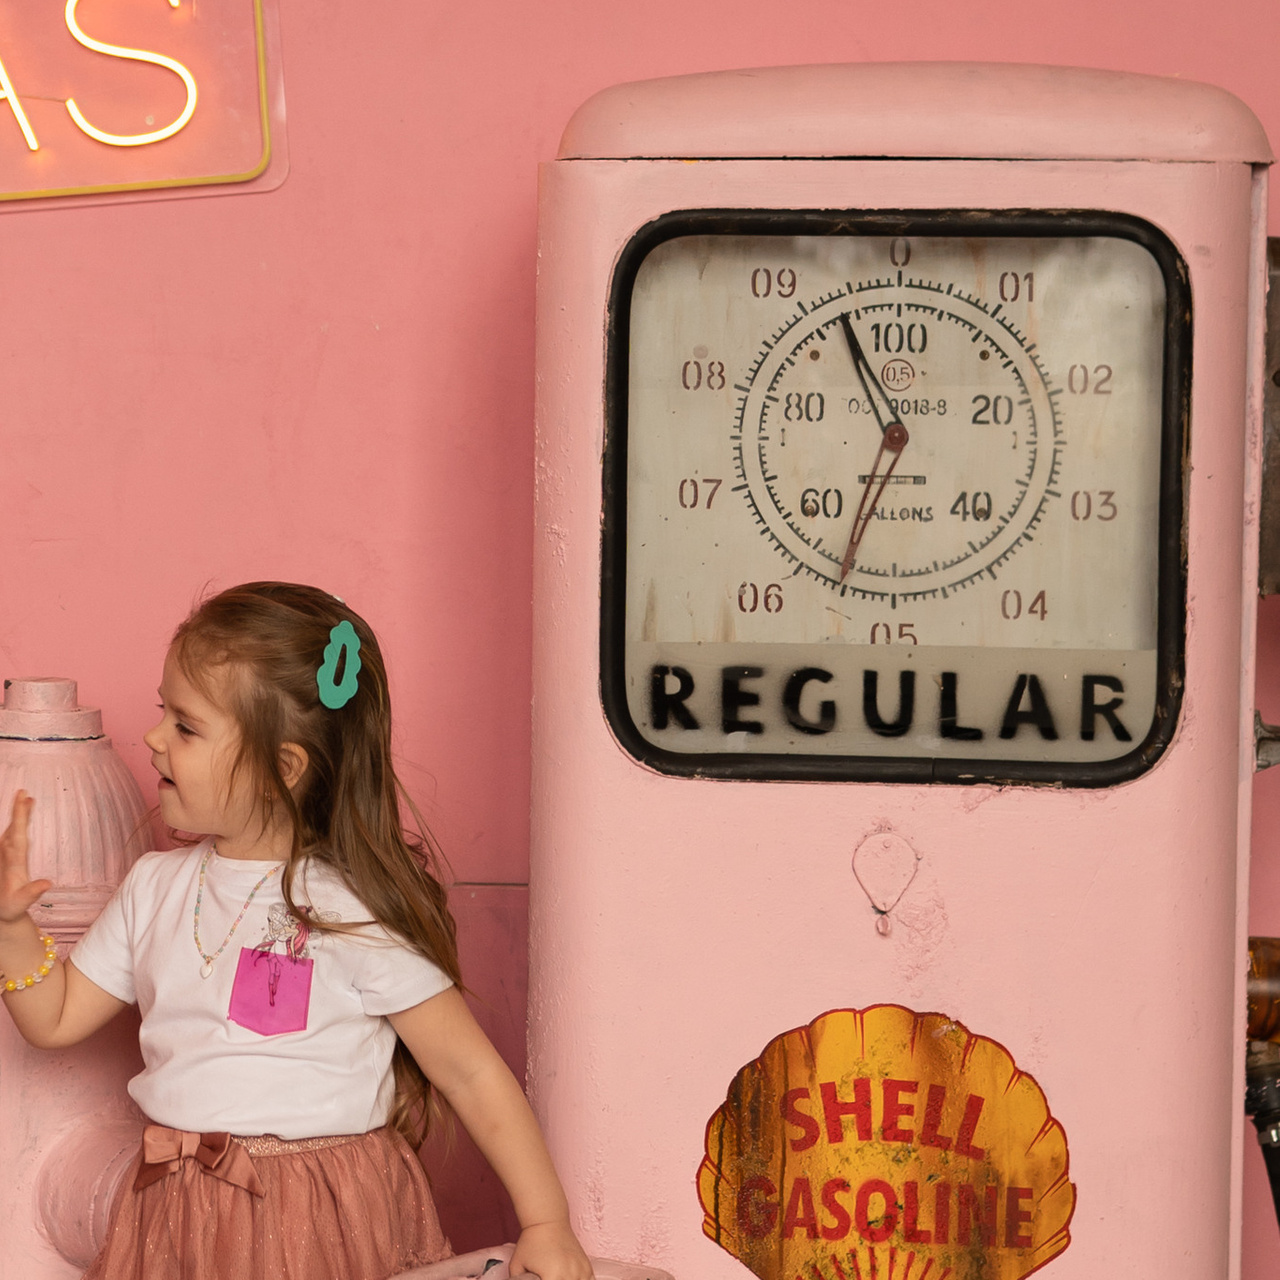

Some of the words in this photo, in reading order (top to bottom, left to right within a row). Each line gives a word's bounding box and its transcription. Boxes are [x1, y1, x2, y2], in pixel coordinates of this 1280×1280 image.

[889, 238, 911, 267] 0
[751, 267, 797, 298] 09
[999, 272, 1036, 303] 01
[870, 322, 928, 354] 100
[681, 360, 727, 391] 08
[885, 366, 910, 385] 0,5
[1068, 364, 1113, 395] 02
[783, 391, 825, 423] 80
[971, 394, 1013, 426] 20
[678, 478, 723, 510] 07
[800, 488, 844, 519] 60
[949, 491, 992, 522] 40
[1070, 490, 1118, 522] 03
[859, 506, 934, 522] ALLONS
[738, 583, 784, 614] 06
[1000, 589, 1048, 621] 04
[870, 622, 918, 646] 05
[648, 663, 1134, 743] REGULAR
[779, 1077, 986, 1161] SHELL
[735, 1174, 1035, 1249] GASOLINE
